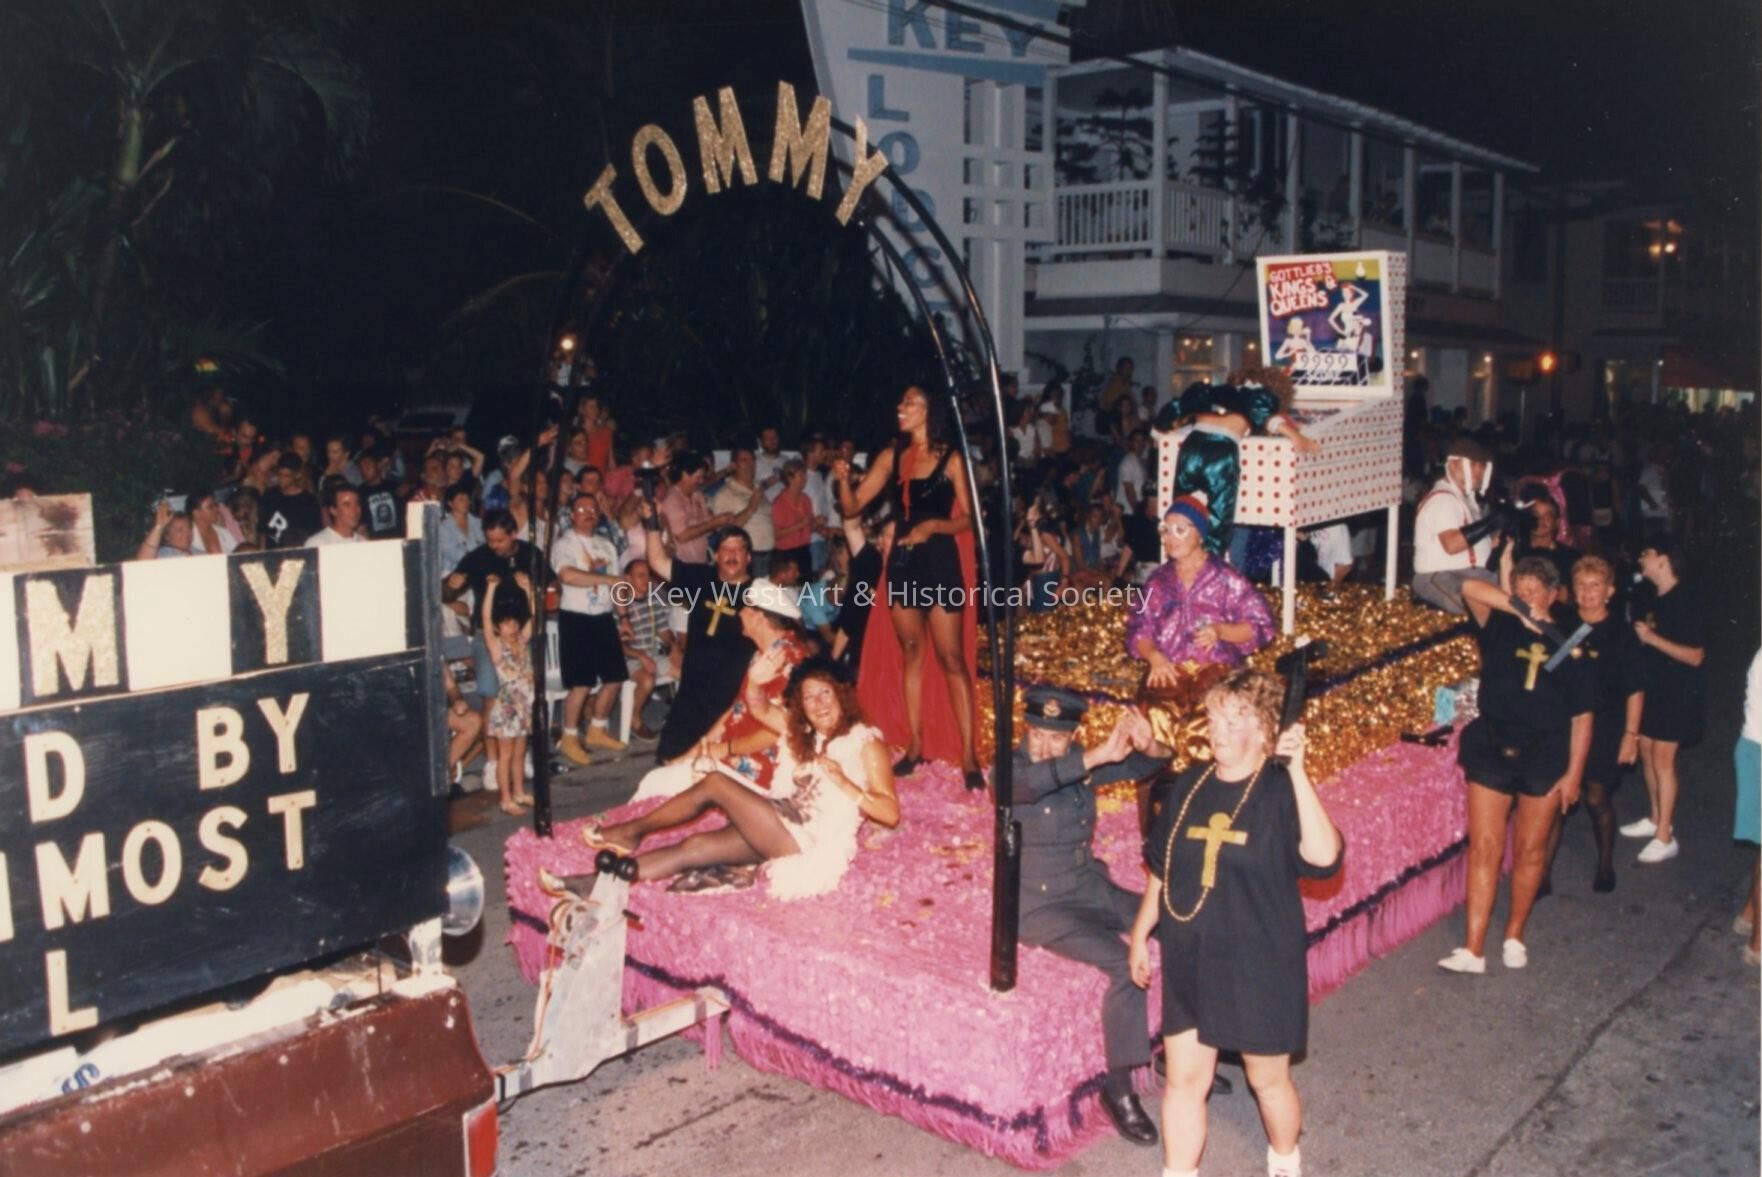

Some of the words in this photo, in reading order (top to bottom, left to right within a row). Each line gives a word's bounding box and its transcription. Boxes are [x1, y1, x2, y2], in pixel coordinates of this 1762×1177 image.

[888, 0, 1044, 57] KEY
[584, 80, 889, 255] TOMMY
[1269, 277, 1316, 298] KINGS
[1270, 262, 1332, 283] GOTTLIEB'S
[1270, 290, 1328, 316] QUEENS
[196, 693, 310, 790] BY
